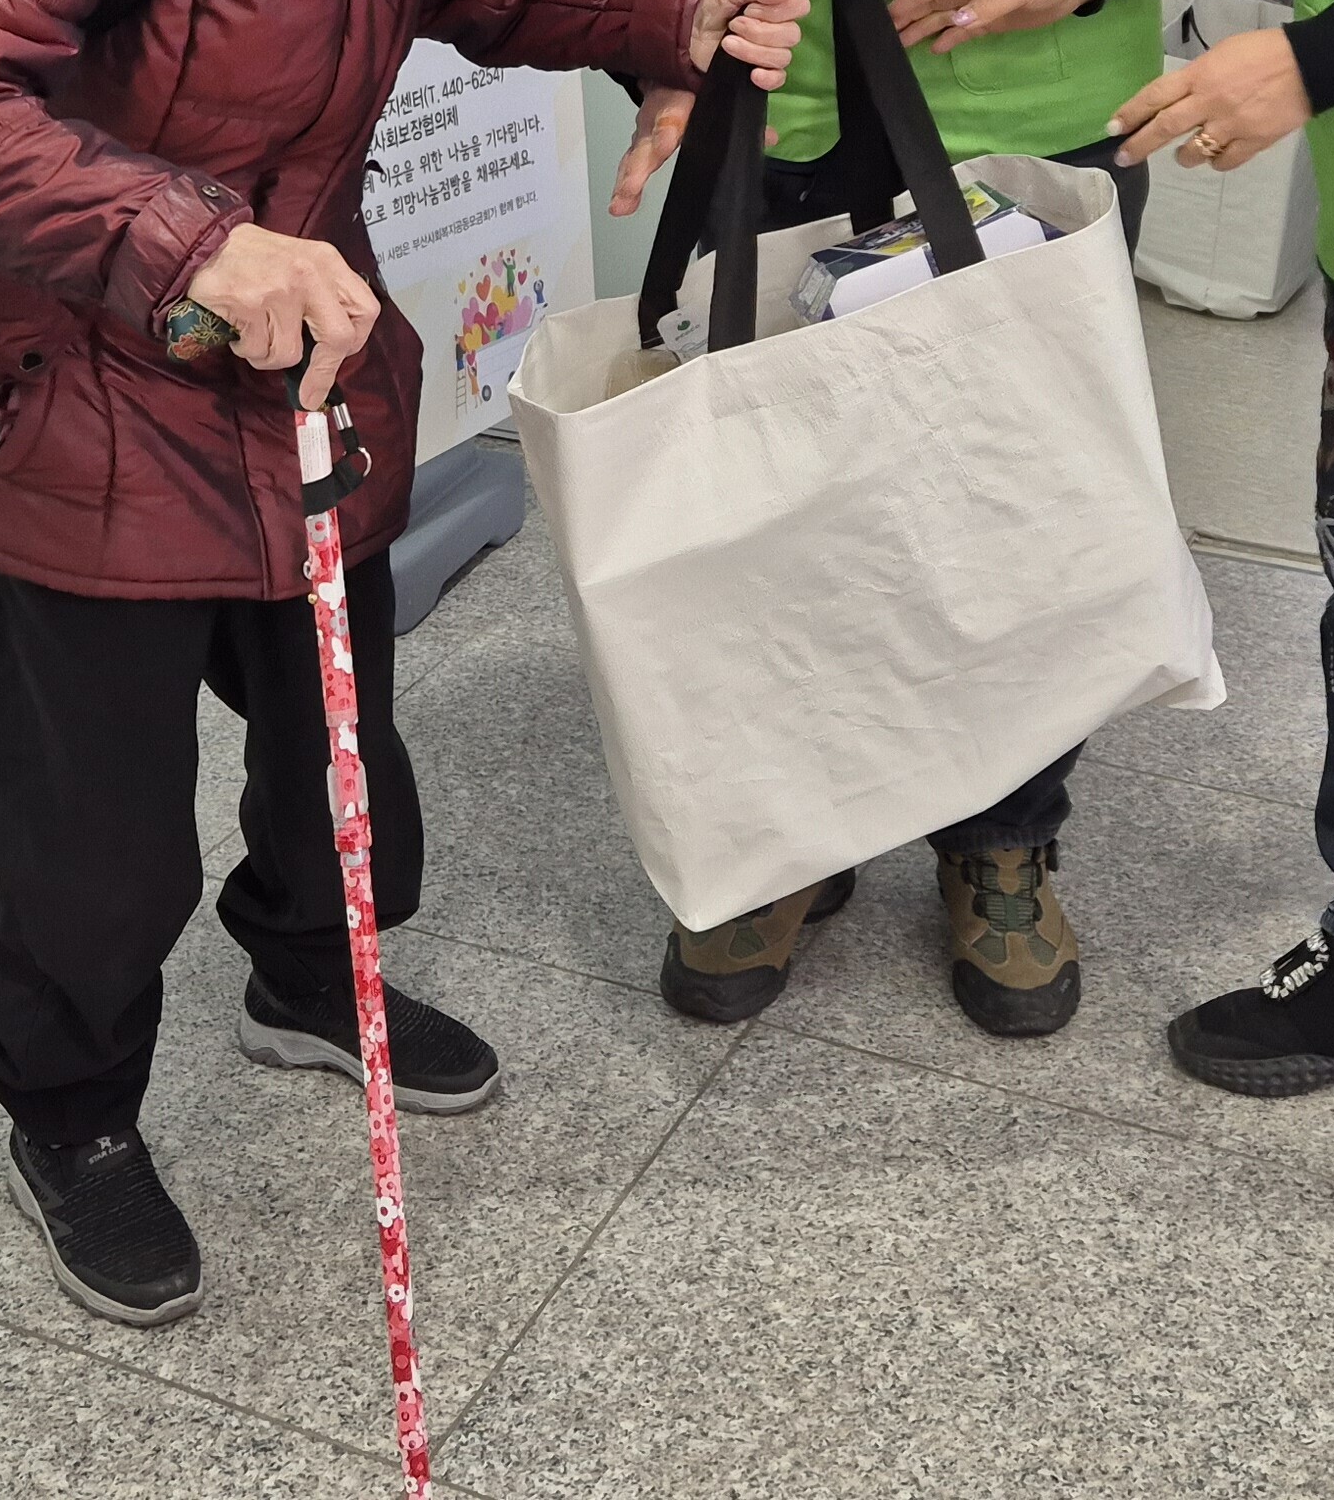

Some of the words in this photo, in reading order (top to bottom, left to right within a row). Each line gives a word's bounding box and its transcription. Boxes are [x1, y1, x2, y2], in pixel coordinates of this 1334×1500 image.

[379, 159, 415, 189] 이웃을
[419, 149, 444, 174] 위한
[447, 134, 482, 163] 나눔을
[485, 114, 545, 149] 기다립니다.
[476, 149, 535, 183] 채워주세요.
